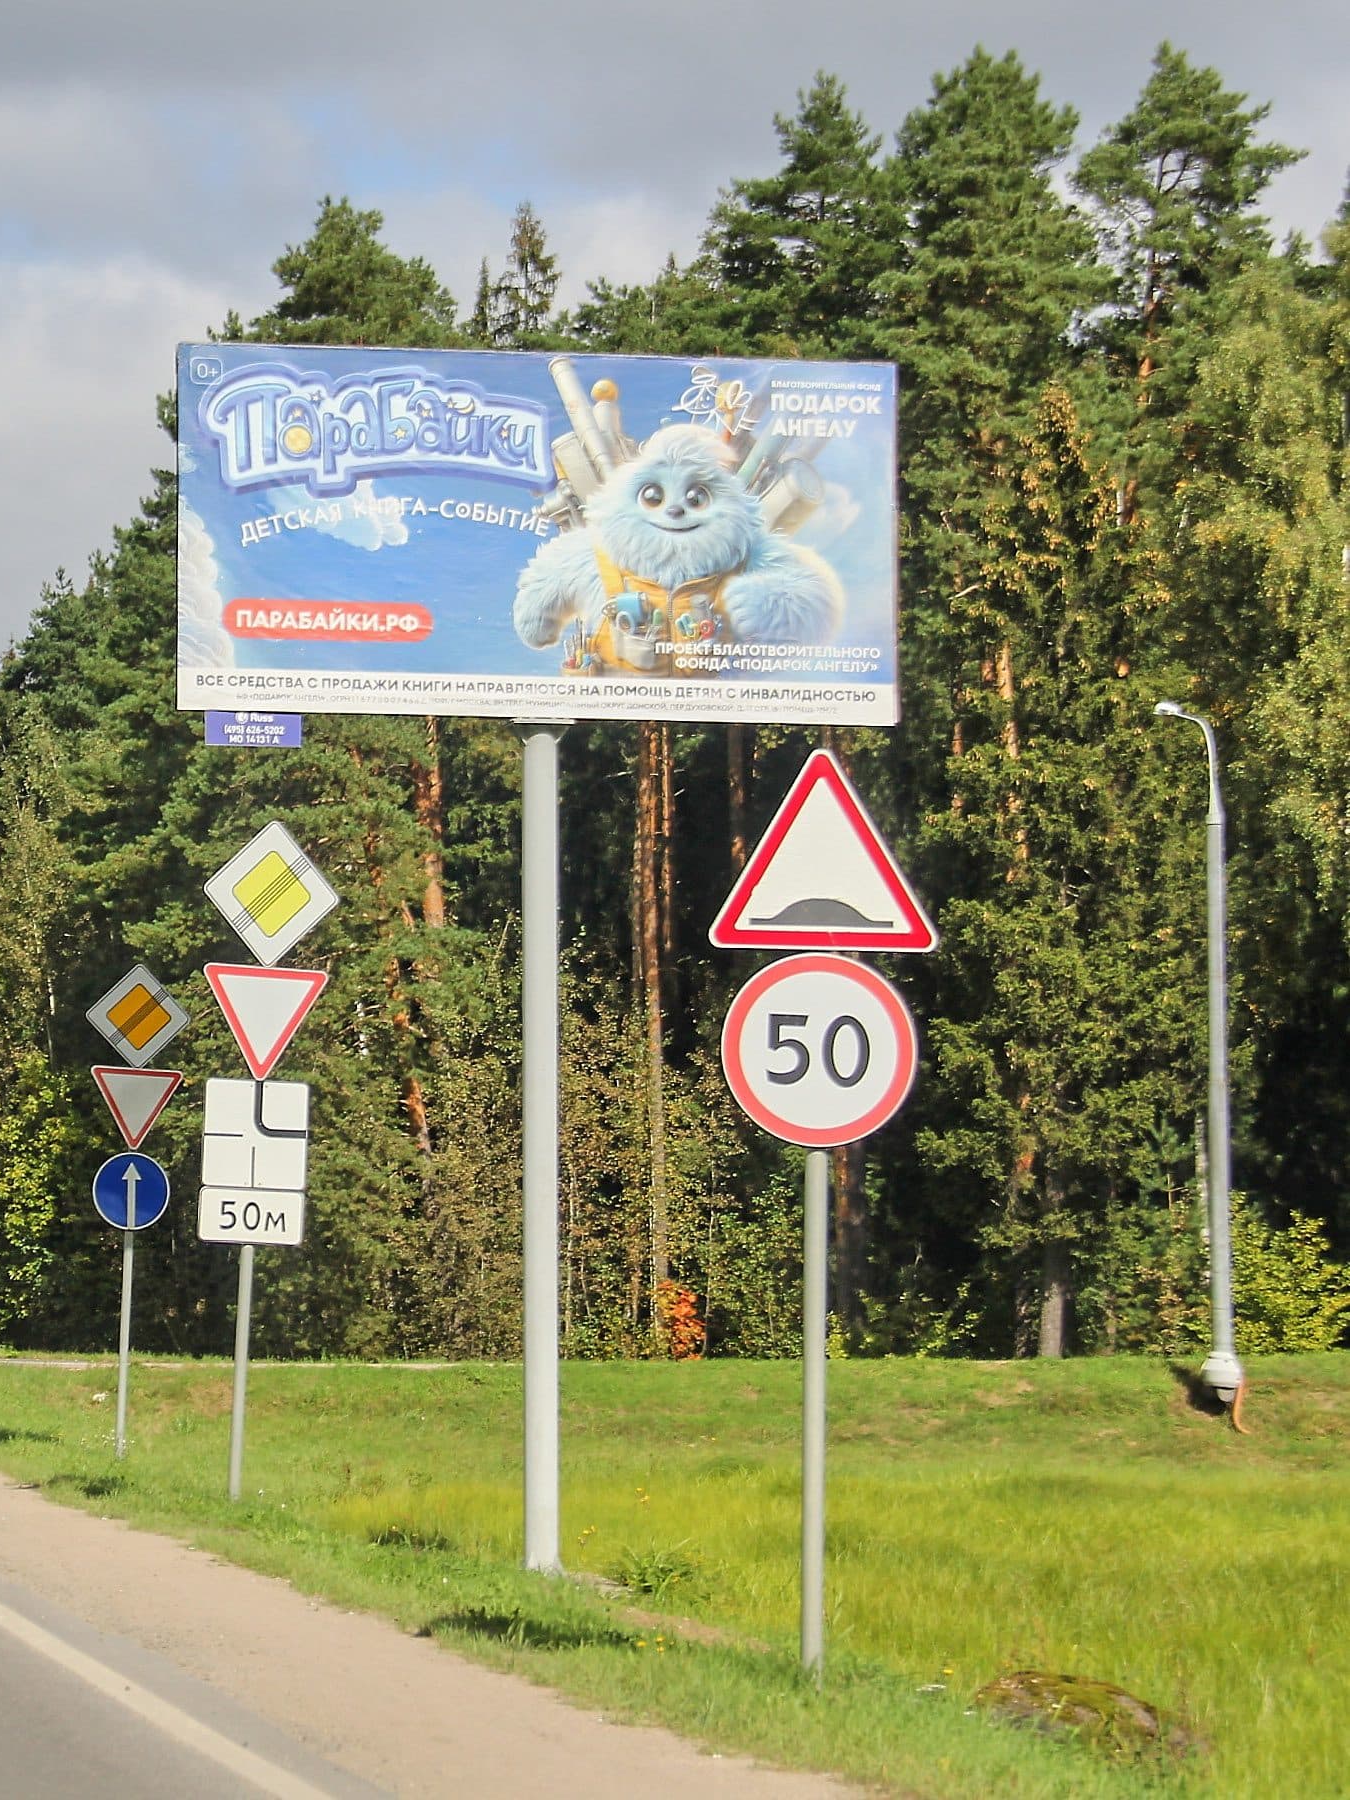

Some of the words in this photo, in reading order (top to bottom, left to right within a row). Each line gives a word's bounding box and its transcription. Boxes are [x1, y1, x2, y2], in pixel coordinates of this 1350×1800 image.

[196, 362, 218, 379] 0+
[856, 383, 882, 392] ФОНД
[770, 393, 882, 415] ПОДАРОК
[771, 417, 858, 438] АНГЕЛУ
[240, 502, 342, 547] ДЕТСКАЯ
[235, 607, 420, 633] ПАРАБАЙКИ.РФ
[654, 642, 712, 656] ПРОЕКТ
[713, 645, 881, 660] БЛАГОТВОРИТЕЛЬНОГО
[675, 656, 730, 672] ФОНДА
[732, 659, 813, 673] «ПОДАРОК
[814, 661, 879, 674] АНГЕЛУ»
[196, 674, 224, 687] ВСЕ
[227, 675, 304, 689] СРЕДСТВА
[307, 677, 318, 689] С
[321, 678, 398, 692] ПРОДАЖИ
[402, 680, 451, 692] КНИГИ
[456, 681, 575, 695] НАПРАВЛЯЮТСЯ
[580, 685, 600, 695] НА
[603, 685, 672, 698] ПОМОЩЬ
[675, 687, 722, 699] ДЕТЯМ
[726, 688, 737, 699] С
[740, 688, 877, 702] ИНВАЛИДНОСТЬЮ
[250, 712, 274, 722] Russ
[224, 725, 244, 735] (495)
[246, 726, 285, 735] 626-5202
[246, 736, 270, 744] 14131
[765, 1013, 870, 1088] 50
